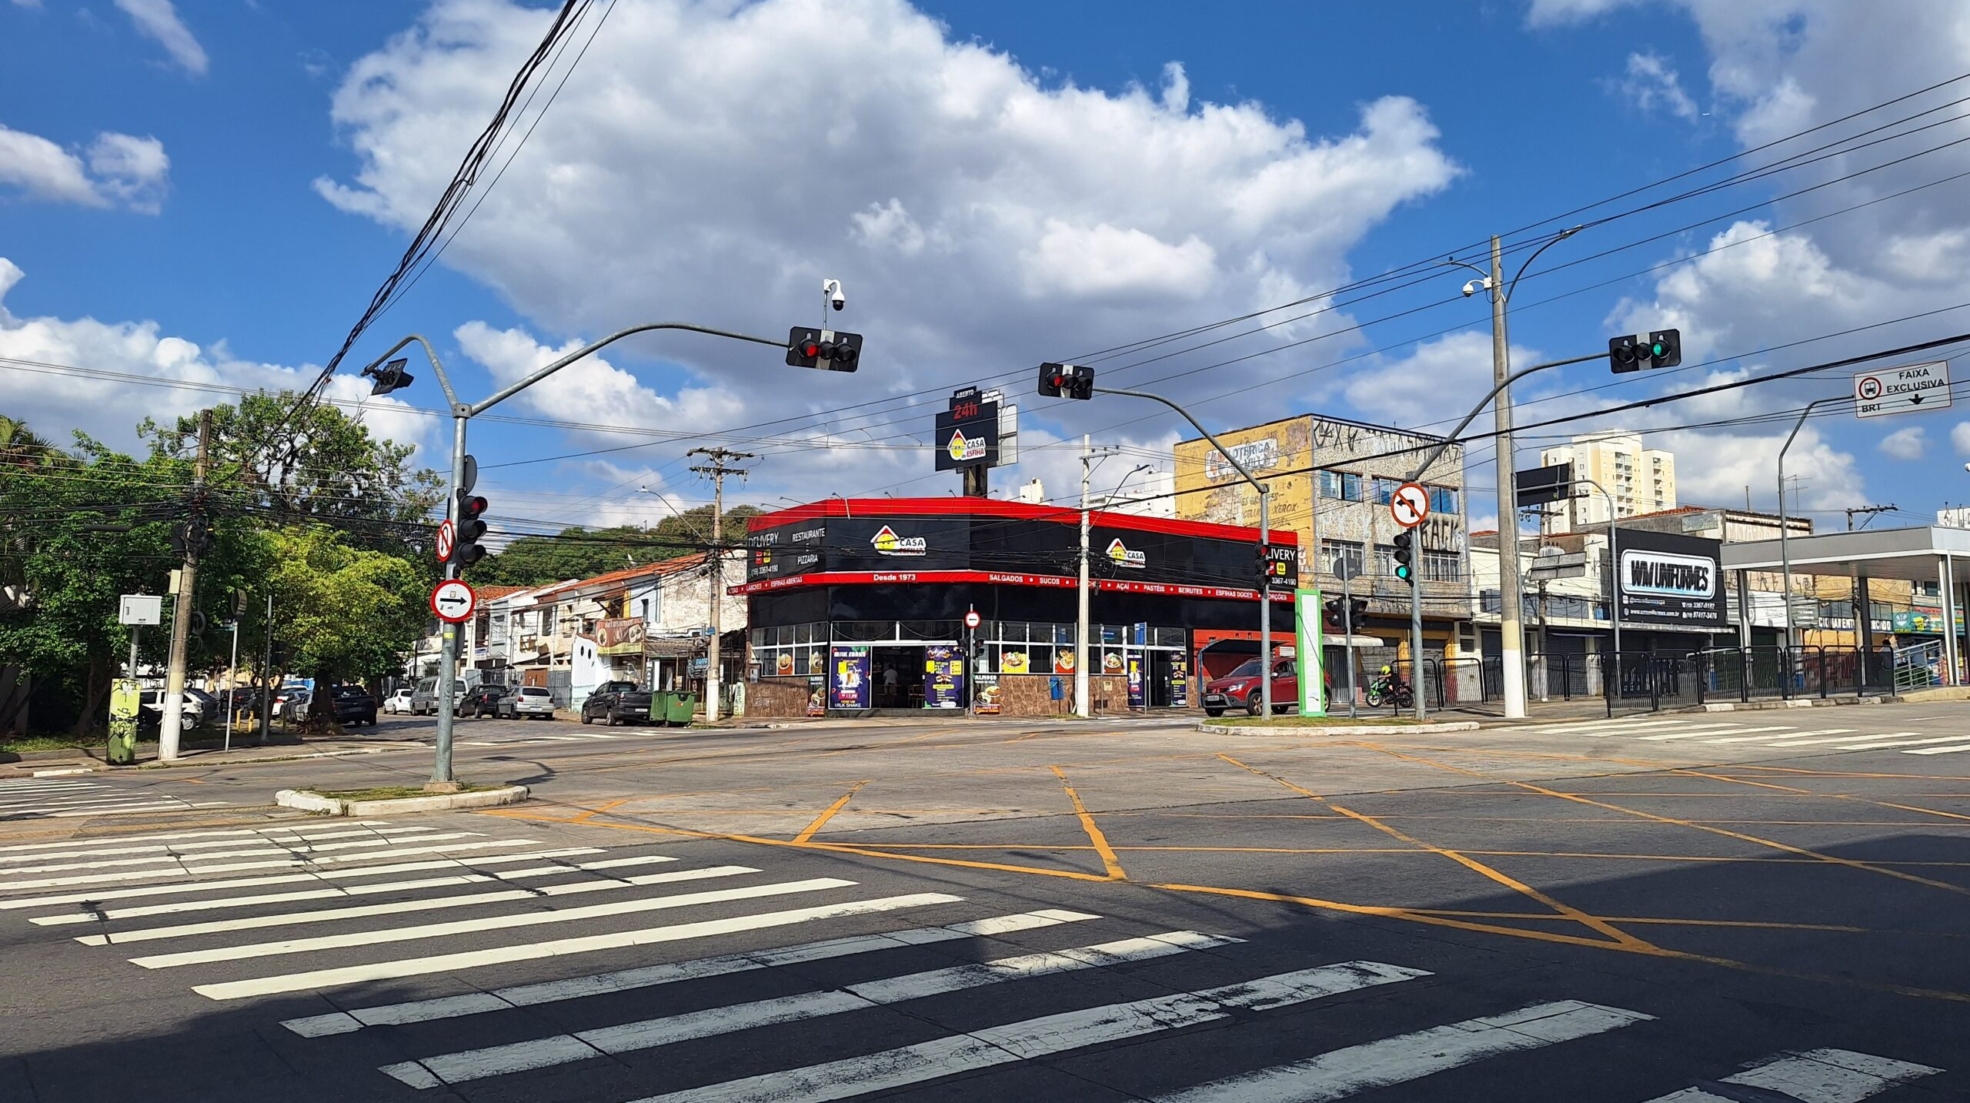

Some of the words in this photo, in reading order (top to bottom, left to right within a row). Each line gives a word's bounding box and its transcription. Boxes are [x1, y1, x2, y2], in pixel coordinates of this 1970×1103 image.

[1899, 368, 1930, 380] FAIXA
[1886, 378, 1945, 394] EXCLUSIVA
[953, 401, 979, 420] 24h
[1861, 402, 1882, 413] BRT
[966, 438, 985, 449] CASA
[792, 528, 826, 542] RESTAURANTE
[900, 539, 925, 547] CASA
[797, 554, 818, 565] PIZZARIA
[1127, 551, 1145, 560] CASA
[1630, 560, 1655, 588] WM
[1655, 561, 1710, 592] UNIFORMES
[989, 574, 1024, 583] SALGADOS
[1178, 586, 1203, 595] BEIRUTES
